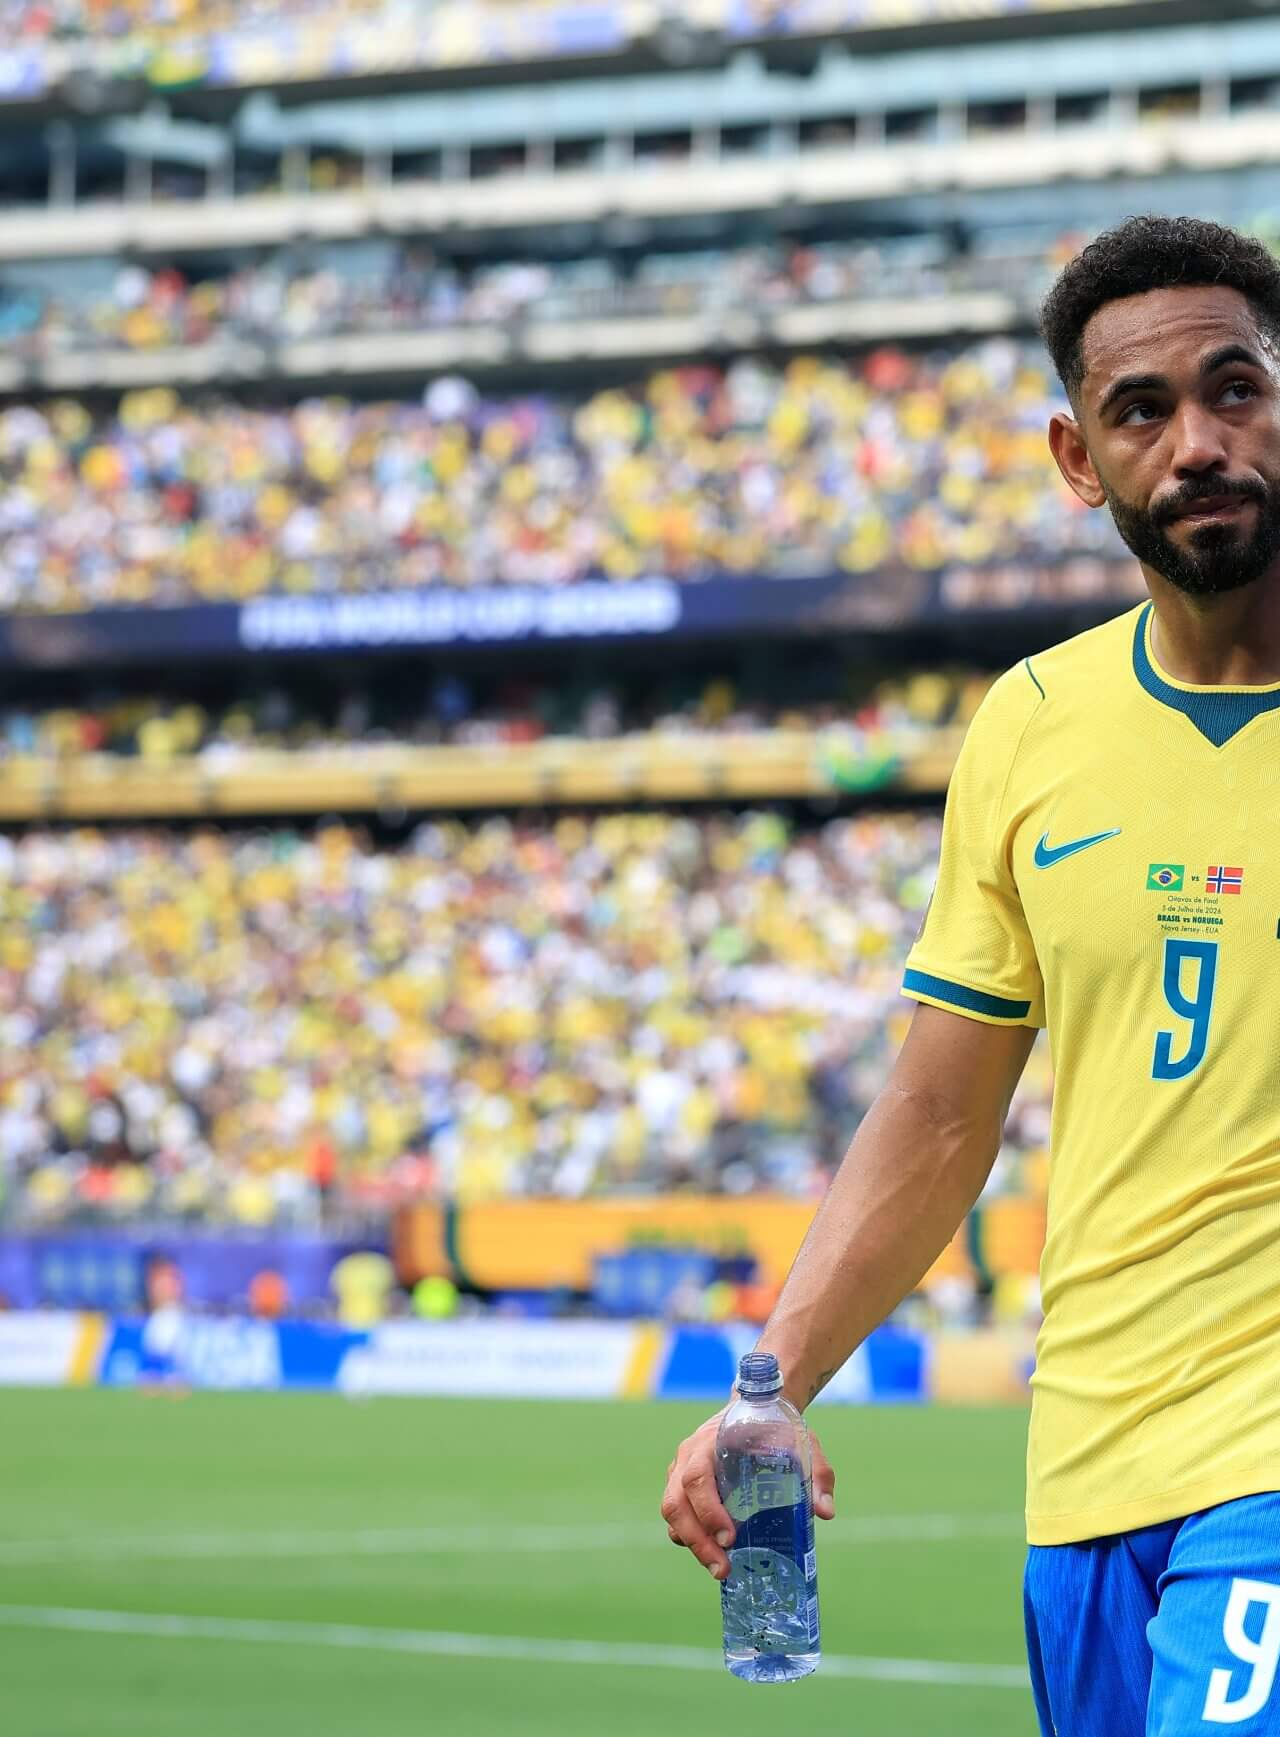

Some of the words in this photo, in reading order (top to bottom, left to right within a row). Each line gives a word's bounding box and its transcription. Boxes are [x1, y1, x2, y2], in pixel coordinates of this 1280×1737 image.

[1157, 914, 1181, 922] BRASIL
[1192, 916, 1224, 925] NORUEGA
[1151, 938, 1219, 1081] 9
